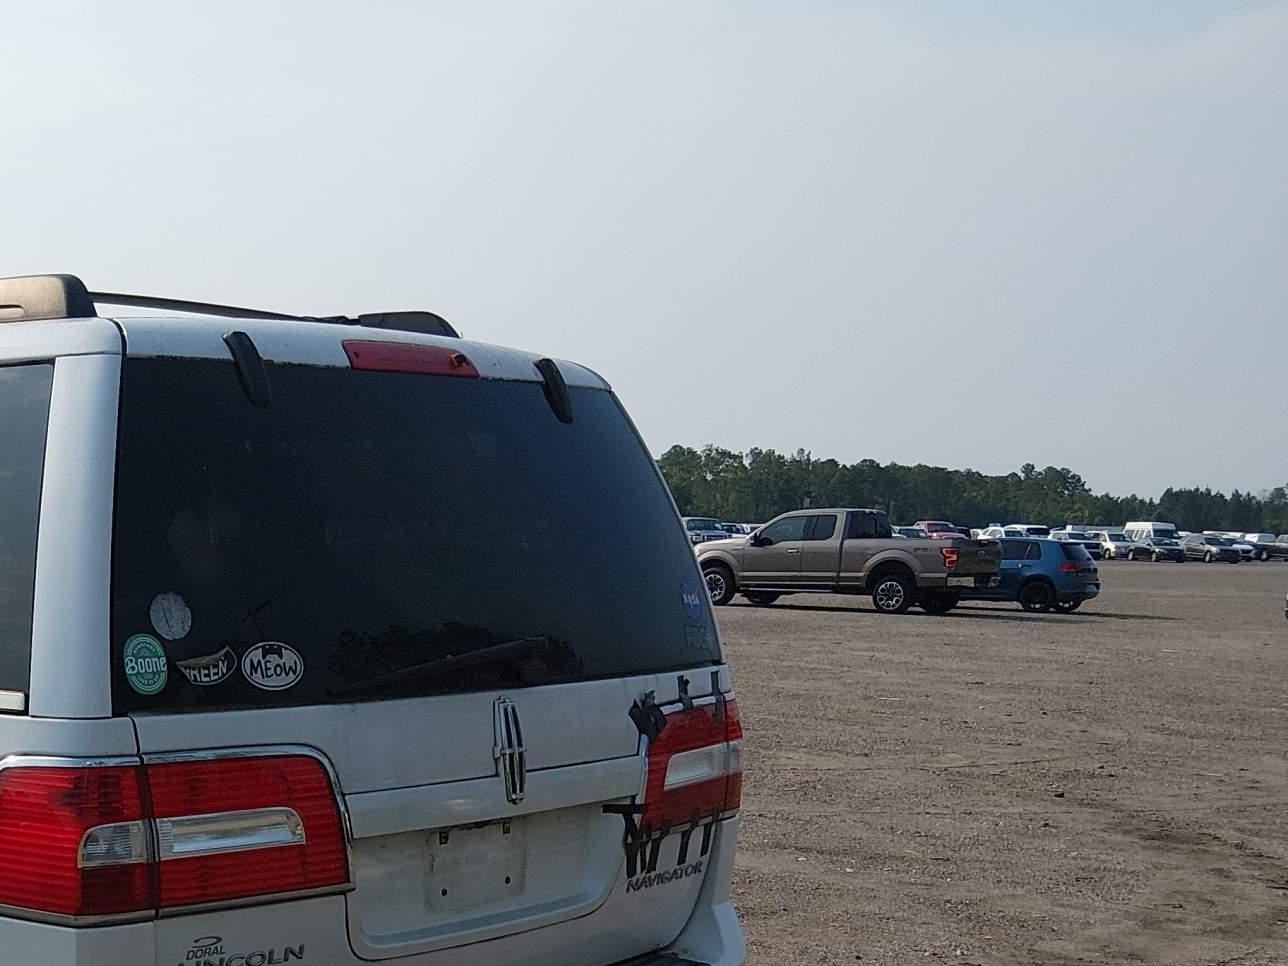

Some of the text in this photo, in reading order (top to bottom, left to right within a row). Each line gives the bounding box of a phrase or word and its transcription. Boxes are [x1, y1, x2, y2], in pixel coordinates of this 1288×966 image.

[125, 656, 168, 675] Boone
[186, 659, 228, 682] REEN
[249, 659, 298, 680] MEOW
[625, 860, 704, 894] NAVIGATOR
[186, 945, 226, 961] DORAL
